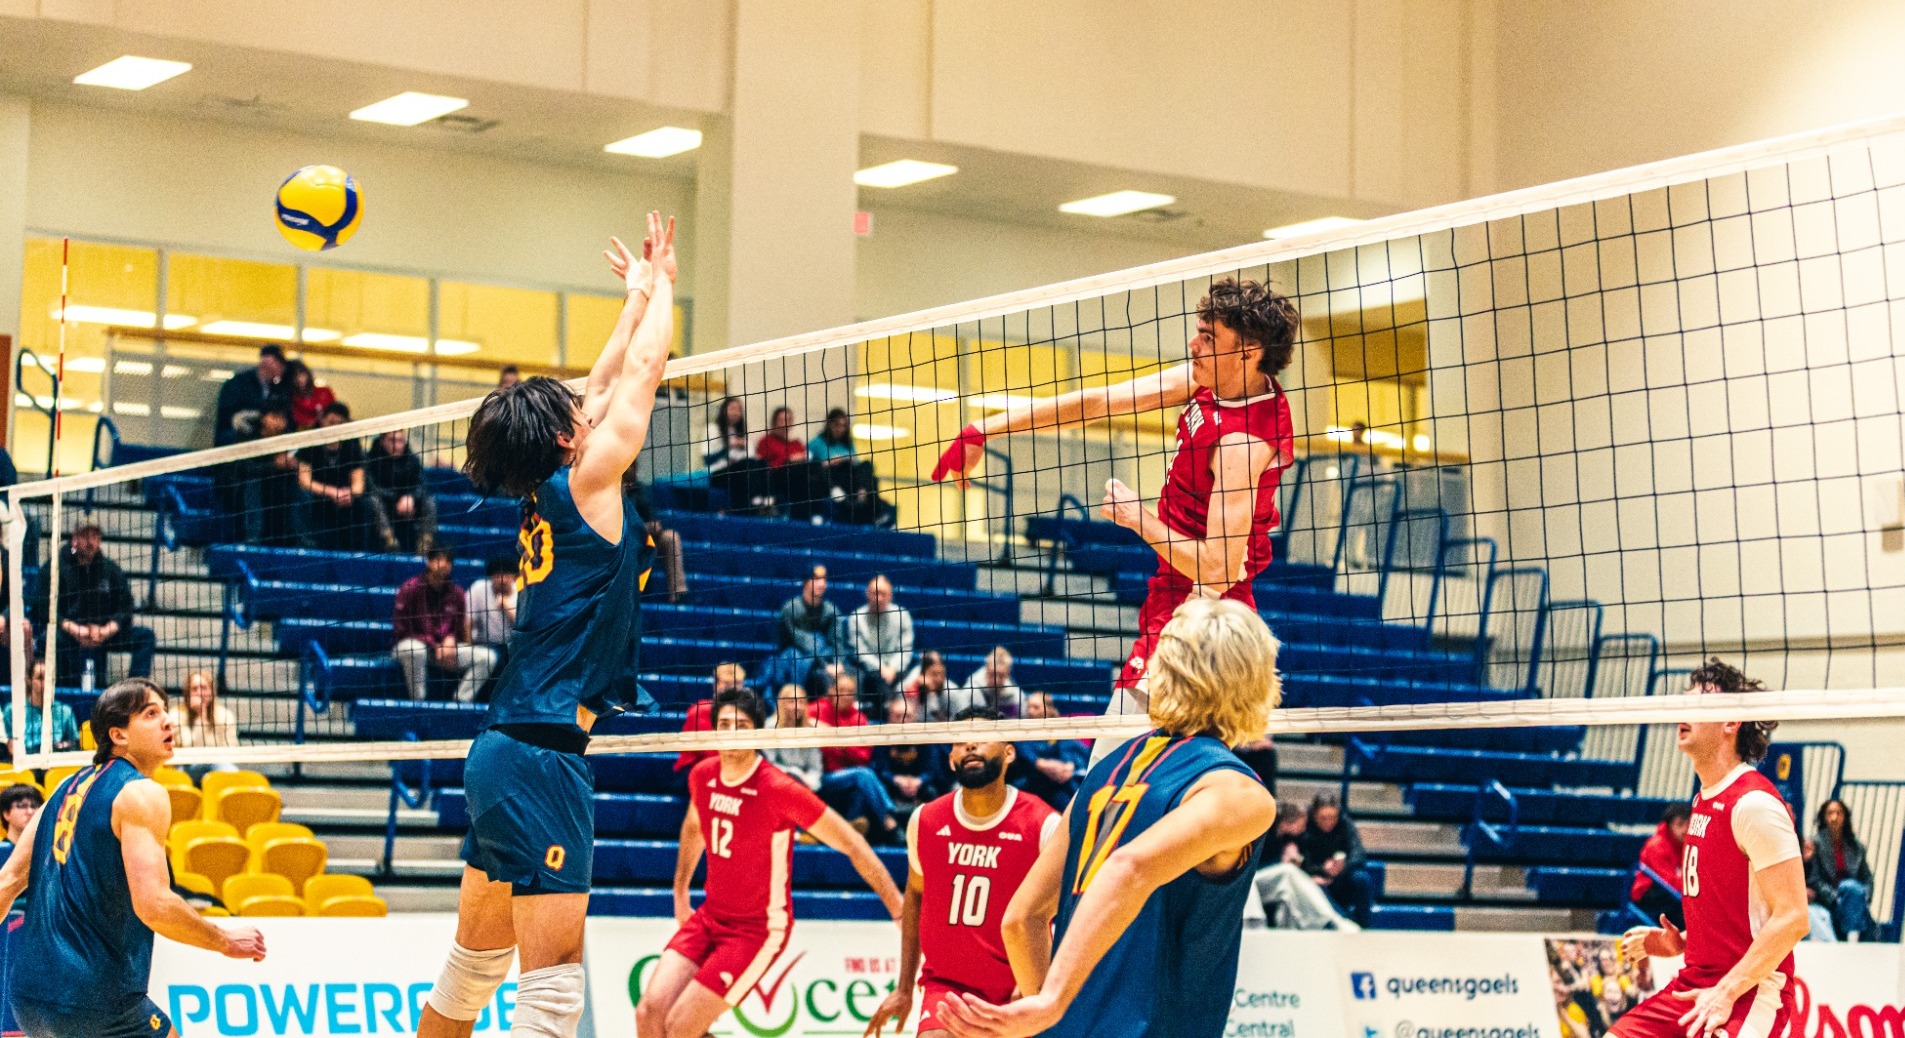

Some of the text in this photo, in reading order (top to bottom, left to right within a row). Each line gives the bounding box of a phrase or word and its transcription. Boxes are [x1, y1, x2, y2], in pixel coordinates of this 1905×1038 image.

[709, 792, 743, 816] YORK
[52, 793, 83, 865] 8
[711, 817, 733, 859] 12
[1072, 782, 1151, 895] 17
[947, 842, 1002, 869] YORK
[1682, 844, 1700, 898] 18
[948, 873, 991, 928] 10
[1234, 988, 1301, 1009] Centre
[1387, 972, 1519, 1000] queensgaels
